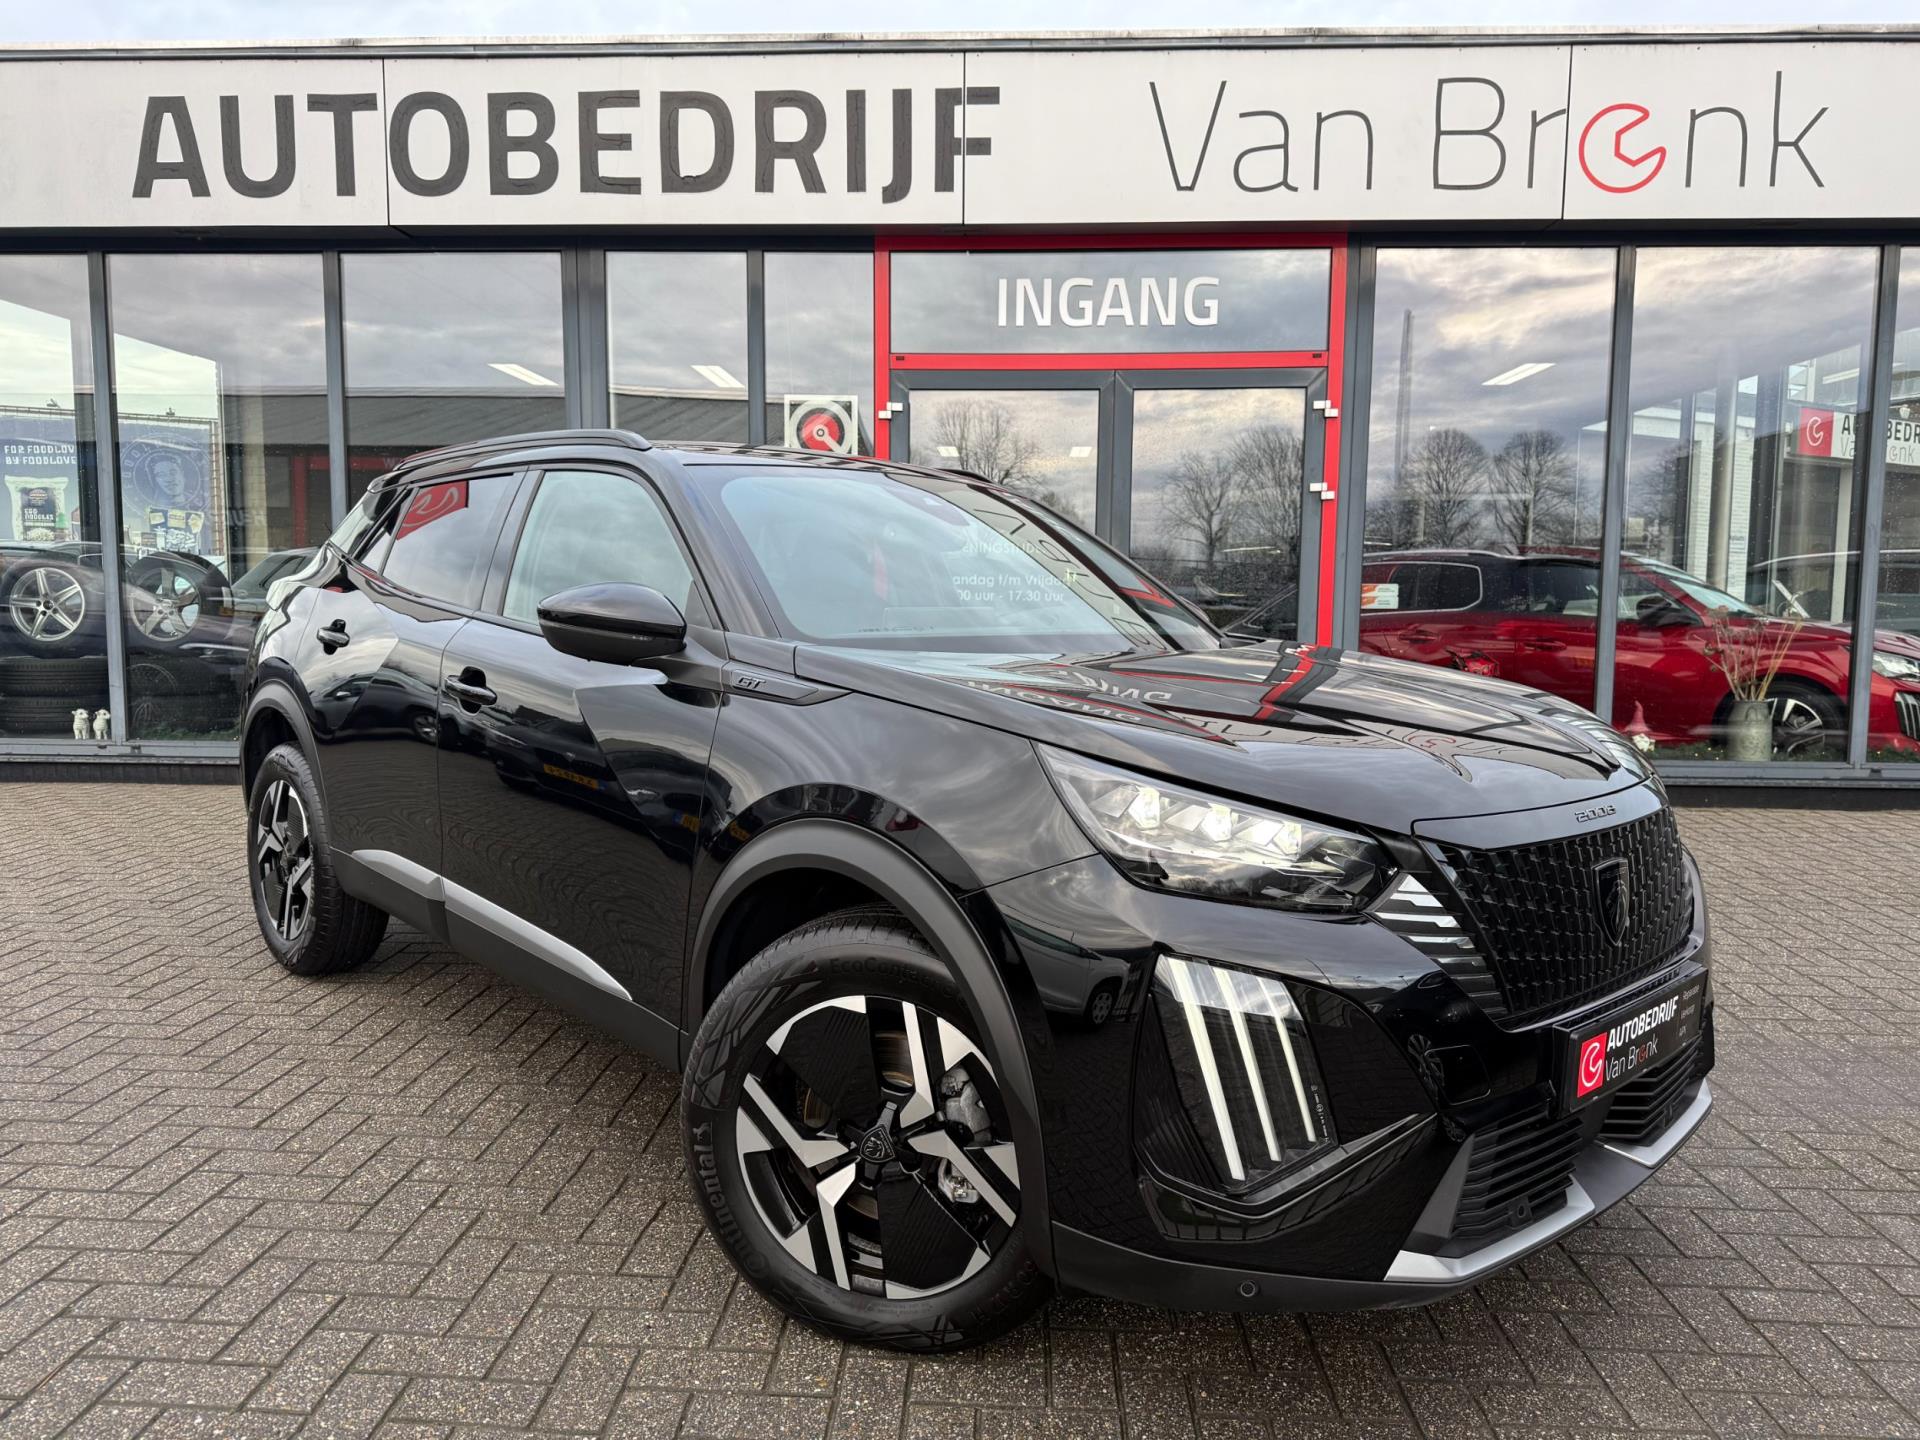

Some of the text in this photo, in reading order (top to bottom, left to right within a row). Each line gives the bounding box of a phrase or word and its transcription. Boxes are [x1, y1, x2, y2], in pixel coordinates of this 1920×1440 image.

[132, 86, 1000, 204] AUTOBEDRIJF
[1149, 70, 1829, 194] Van Bronk
[998, 276, 1220, 328] INGANG
[1606, 995, 1679, 1052] AUTOBEDRIJF
[1605, 1056, 1626, 1081] Van
